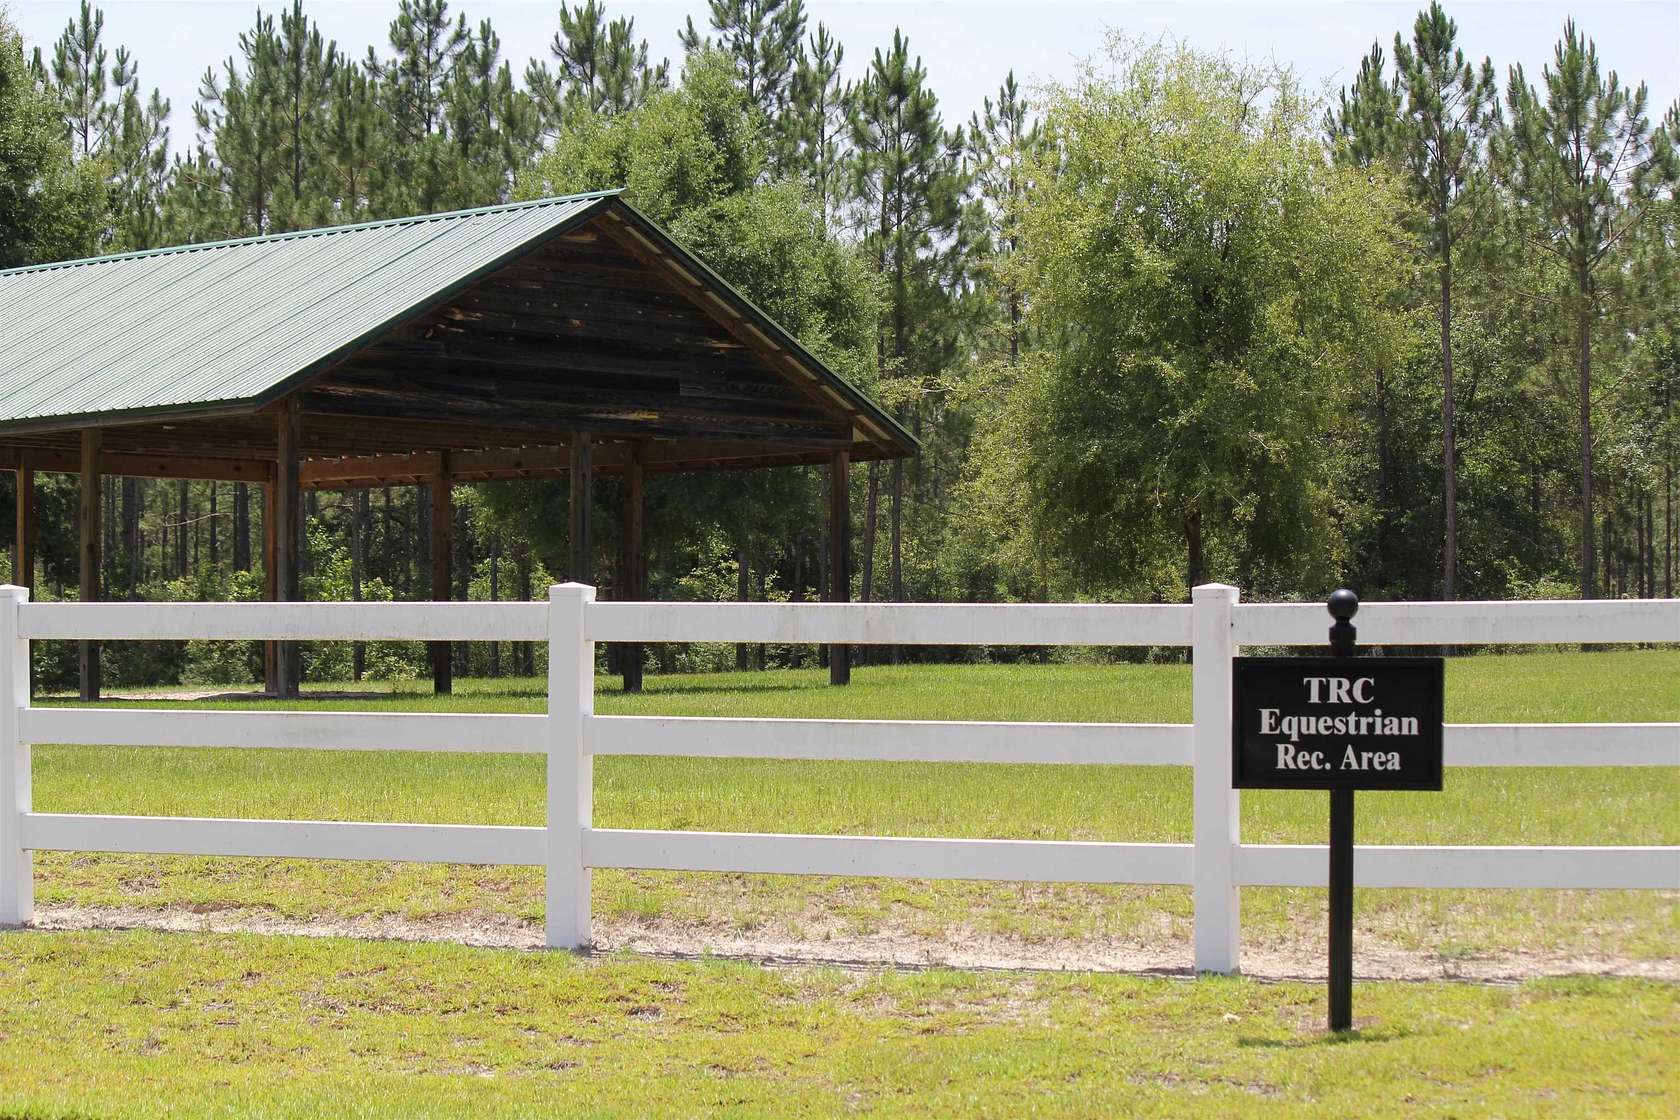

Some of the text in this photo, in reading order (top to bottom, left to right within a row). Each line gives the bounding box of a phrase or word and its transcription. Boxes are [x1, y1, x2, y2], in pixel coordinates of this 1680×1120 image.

[1303, 677, 1375, 704] TRC
[1258, 708, 1419, 742] Equestrian
[1276, 743, 1401, 771] Rec. Area
